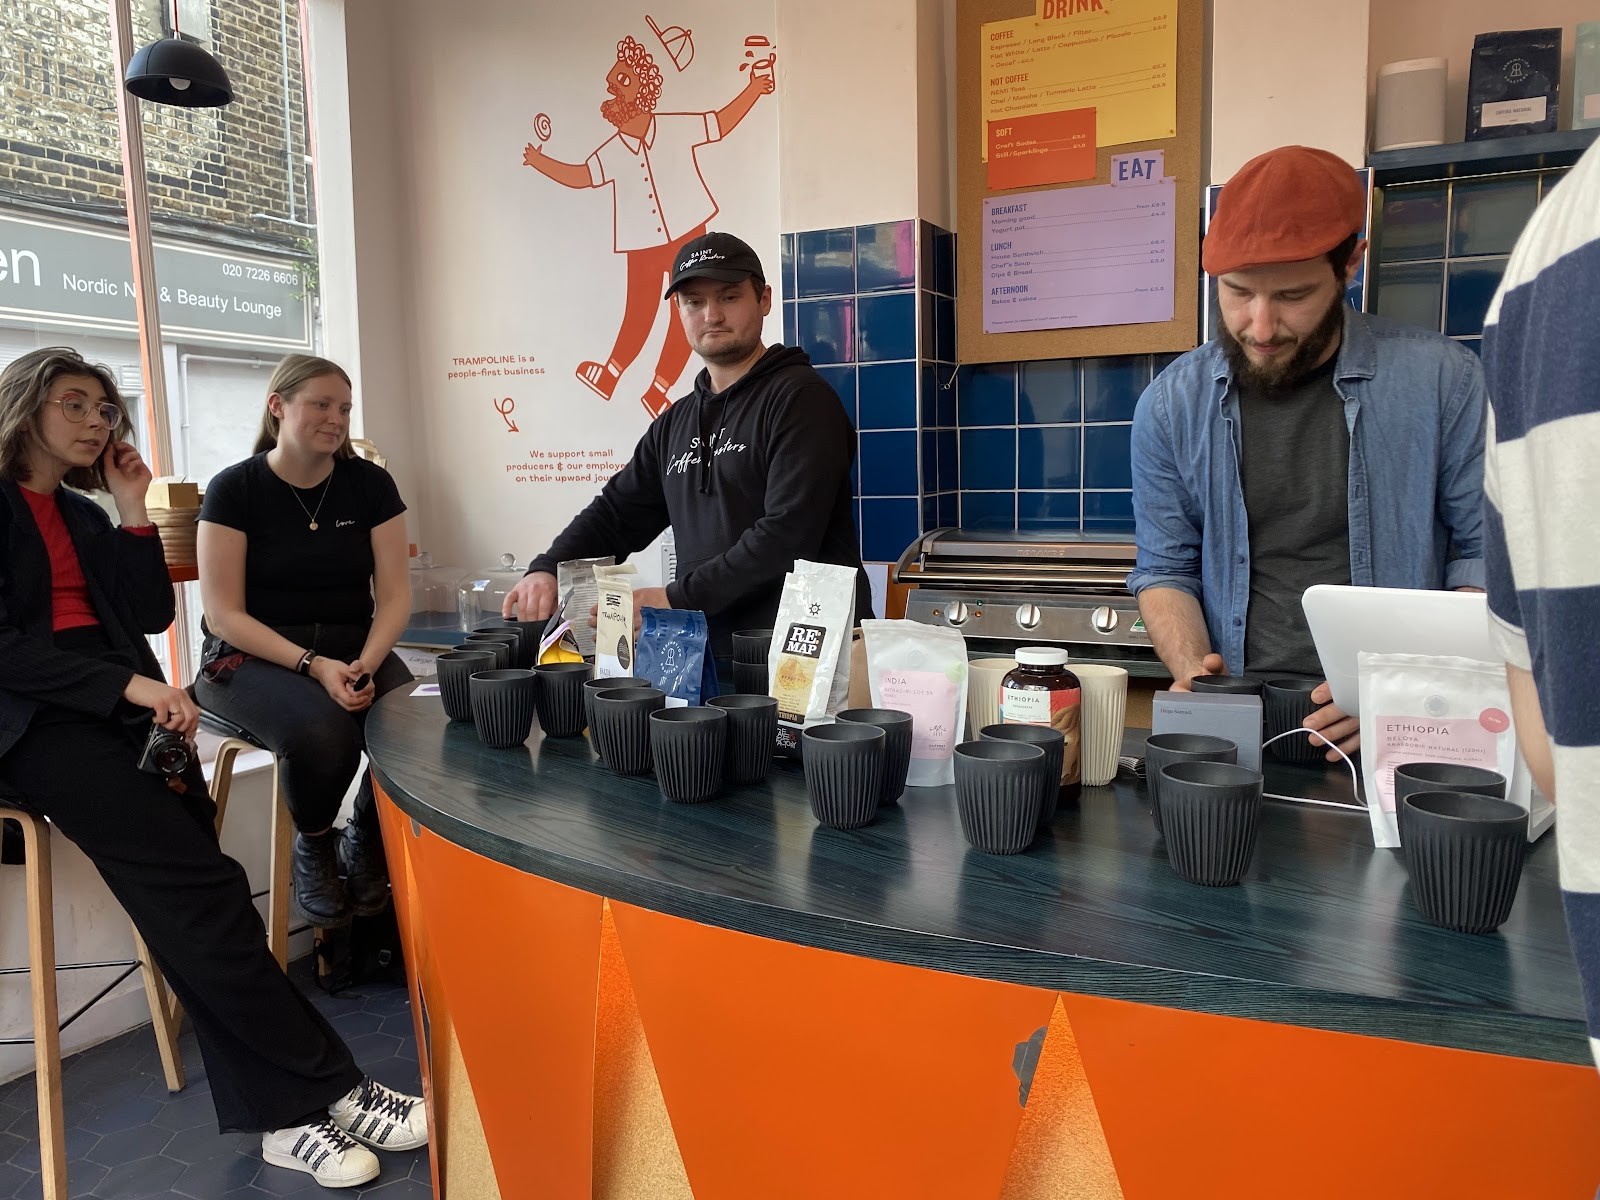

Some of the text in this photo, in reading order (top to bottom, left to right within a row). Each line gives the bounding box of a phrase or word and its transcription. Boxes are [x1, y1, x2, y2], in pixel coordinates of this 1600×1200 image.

[990, 30, 1014, 42] COFFEE
[1047, 32, 1066, 41] Black
[1005, 49, 1025, 57] White
[990, 73, 1029, 87] NOT COFFEE
[1004, 102, 1038, 112] Chocolate
[995, 127, 1013, 138] SOFT
[995, 142, 1014, 150] Craft
[1118, 158, 1156, 181] EAT
[991, 204, 1028, 216] BREAKFAST
[991, 241, 1012, 252] LUNCH
[691, 249, 713, 258] SAINT
[1012, 249, 1044, 258] Sandwich
[222, 263, 299, 286] 020 7226 6606
[63, 273, 118, 297] Nordic
[991, 285, 1029, 296] AFTERNOON
[160, 286, 172, 303] &
[177, 289, 229, 313] Beauty
[233, 297, 282, 319] Lounge
[452, 355, 516, 367] TRAMPOLINE
[518, 354, 527, 363] is
[448, 367, 545, 380] people-first business
[529, 449, 614, 464] We support small
[506, 462, 554, 473] producers
[557, 461, 564, 472] &
[586, 460, 627, 473] employe
[515, 474, 527, 483] on
[529, 473, 553, 483] their
[555, 473, 592, 484] upward
[789, 626, 822, 645] RE:
[786, 643, 818, 656] MAP
[885, 677, 907, 685] INDIA
[1007, 695, 1040, 703] ETHIOPIA
[1387, 724, 1449, 735] ETHIOPIA
[1428, 745, 1460, 753] NATURAL
